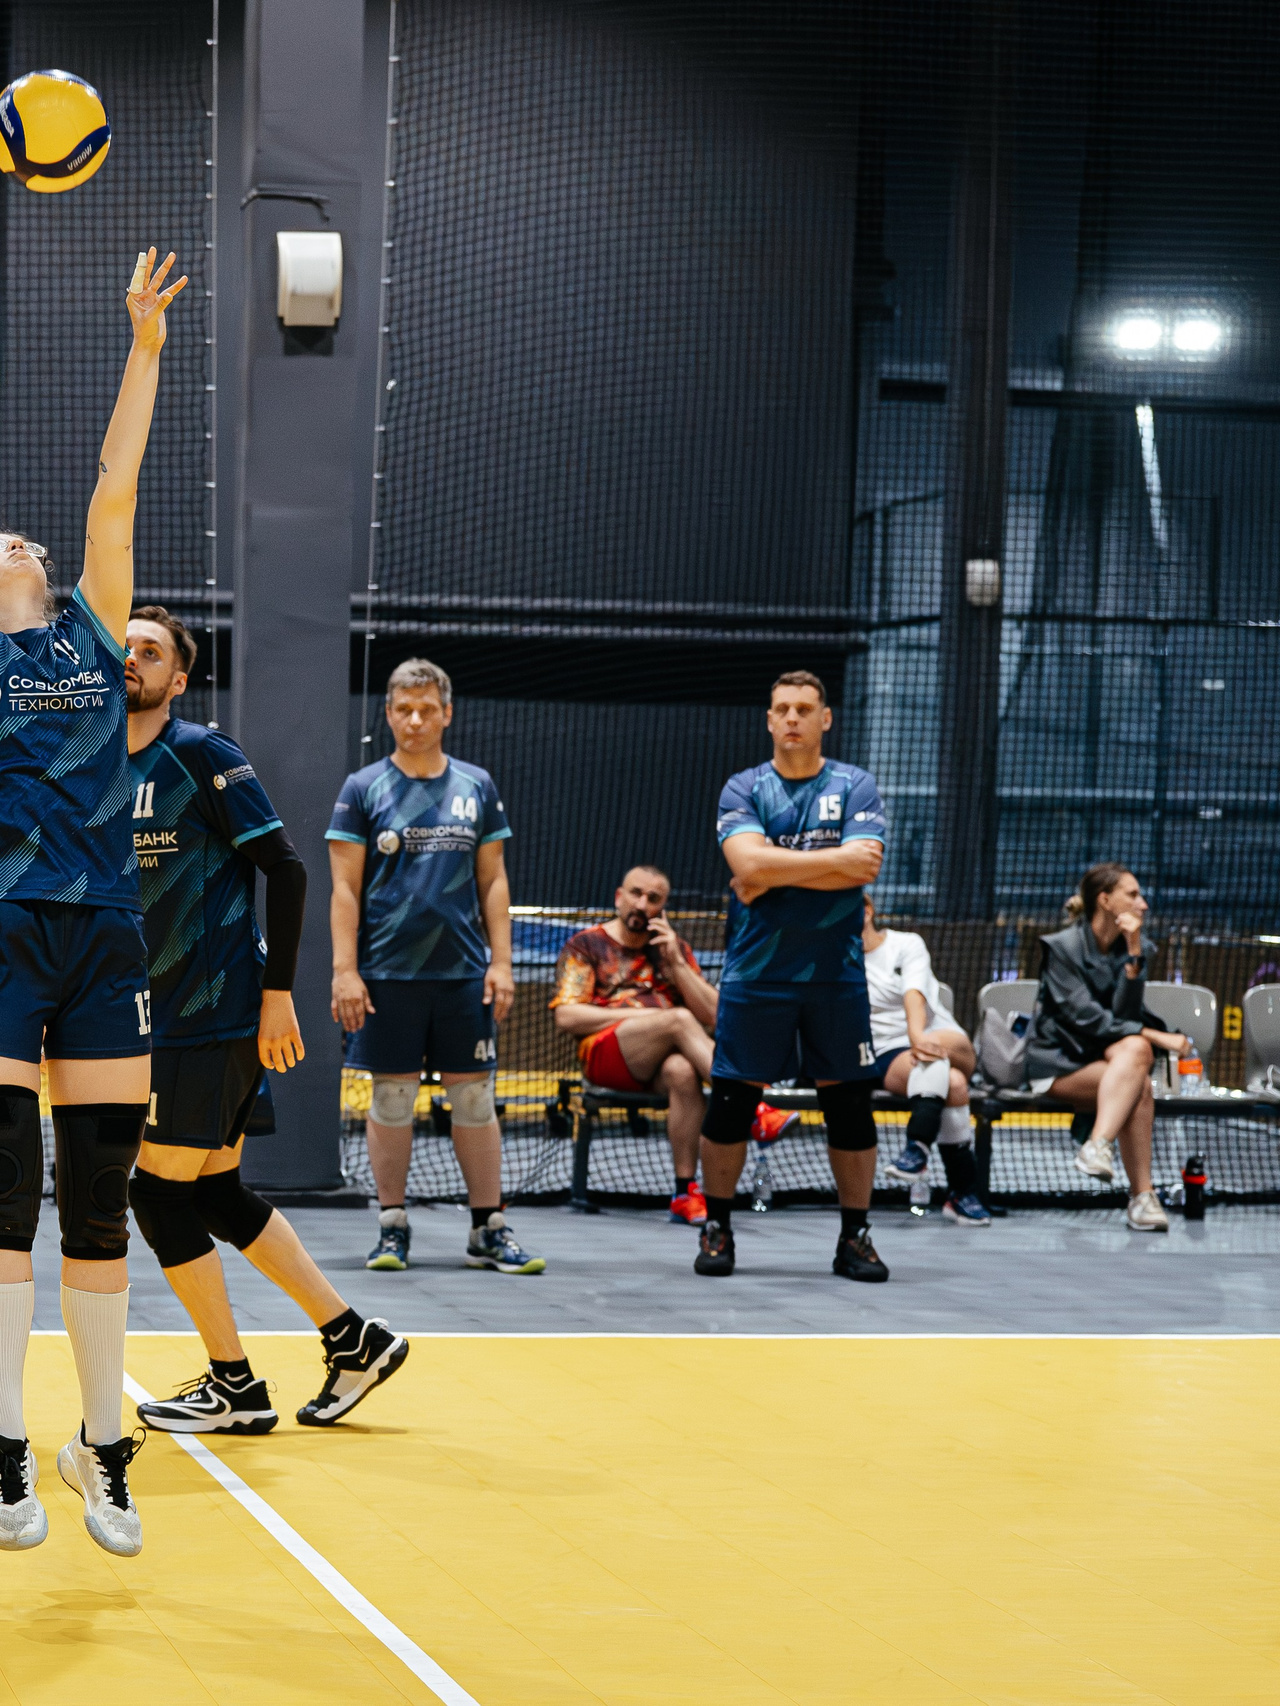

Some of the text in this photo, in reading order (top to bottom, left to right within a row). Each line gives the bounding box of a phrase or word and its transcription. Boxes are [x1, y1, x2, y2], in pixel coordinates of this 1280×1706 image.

[132, 781, 155, 819] 11
[450, 795, 478, 823] 44
[818, 794, 842, 821] 15
[137, 855, 159, 868] ИИ
